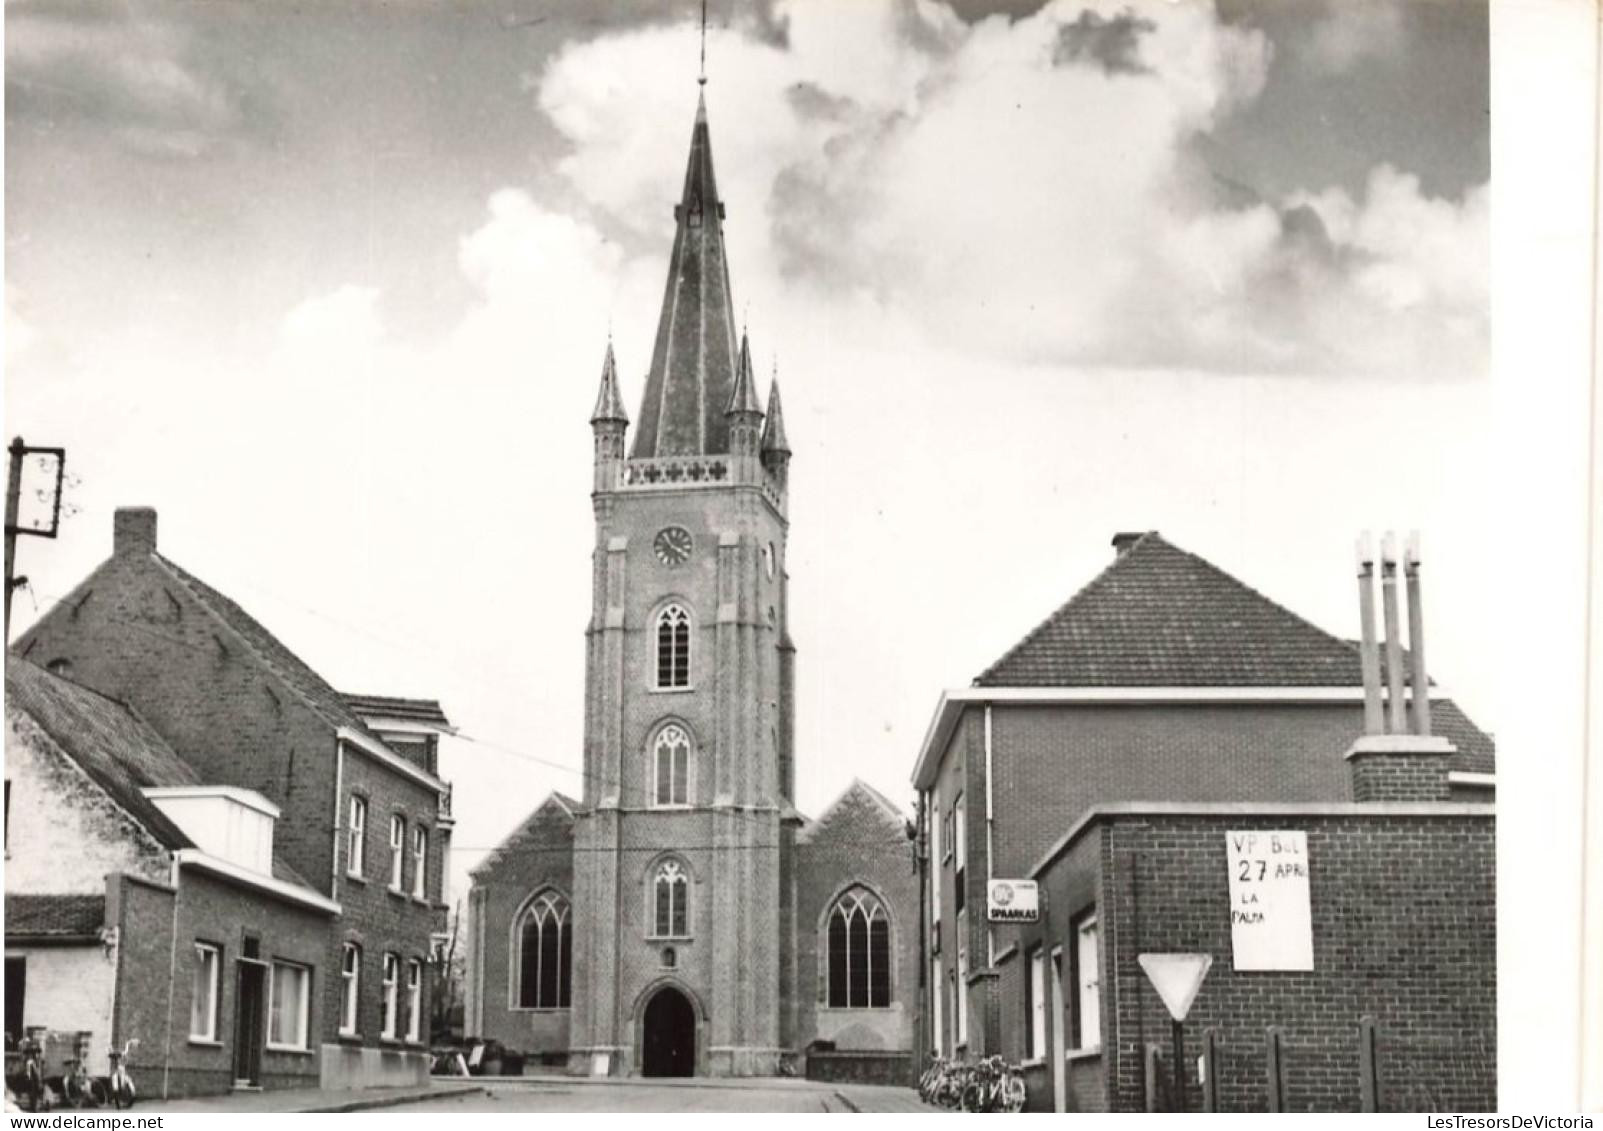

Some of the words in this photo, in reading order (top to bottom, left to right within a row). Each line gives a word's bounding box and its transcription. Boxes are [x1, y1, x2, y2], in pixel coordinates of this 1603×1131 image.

[1233, 834, 1257, 854] VP
[1238, 859, 1267, 882] 27
[1241, 893, 1258, 904] LA
